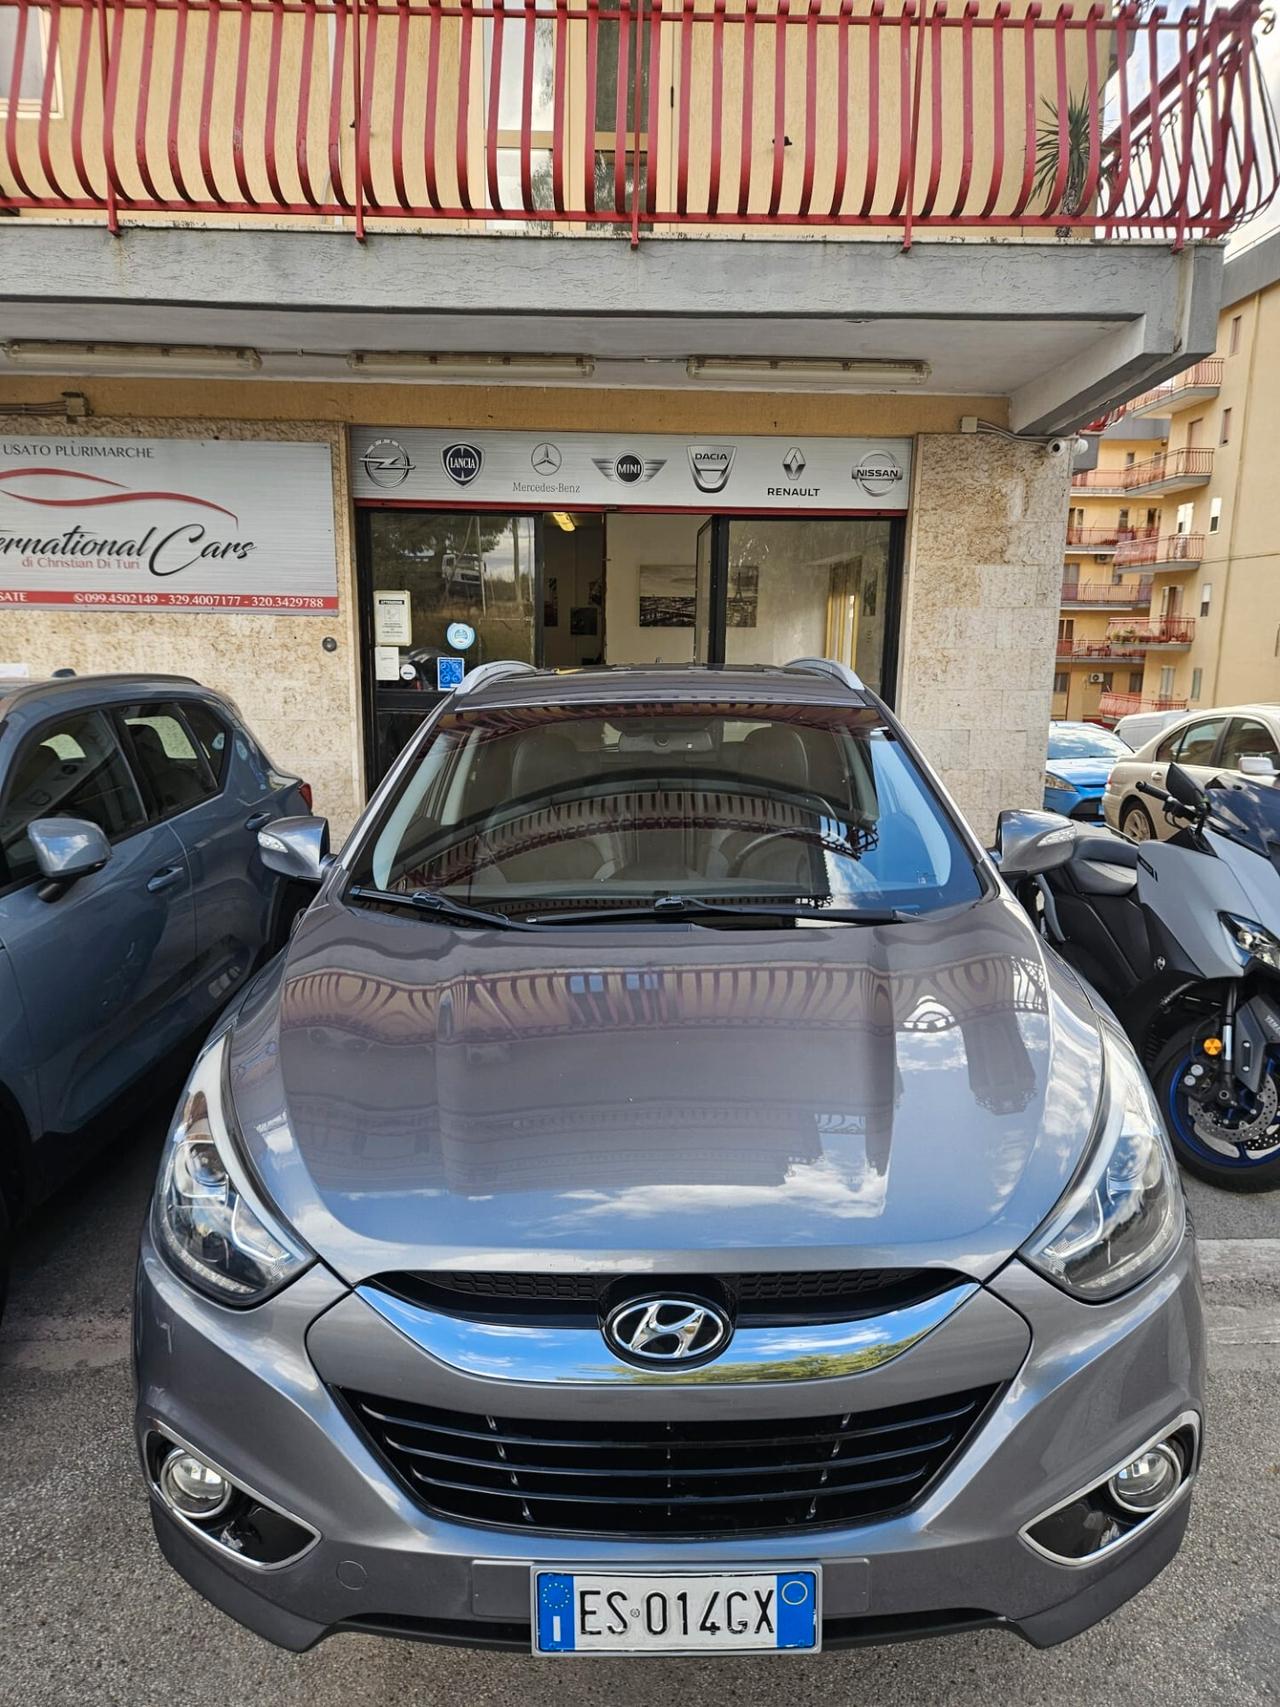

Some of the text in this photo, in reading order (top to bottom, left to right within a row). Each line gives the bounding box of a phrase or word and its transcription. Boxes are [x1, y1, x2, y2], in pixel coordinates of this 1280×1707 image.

[3, 444, 154, 459] USATO PLURIMARCHE
[695, 453, 727, 461] DACIA
[450, 457, 476, 469] LANCIA
[618, 464, 640, 474] MINI
[856, 469, 898, 478] NISSAN
[512, 481, 580, 493] Mercedes-Benz
[767, 488, 820, 497] RENAULT
[149, 523, 256, 576] Cars
[22, 557, 140, 570] di Christian Di Turi
[84, 593, 158, 605] 099.4502149
[168, 595, 240, 606] 329.4007177
[251, 597, 324, 609] 320.3429788
[579, 1589, 775, 1636] ES 014GX
